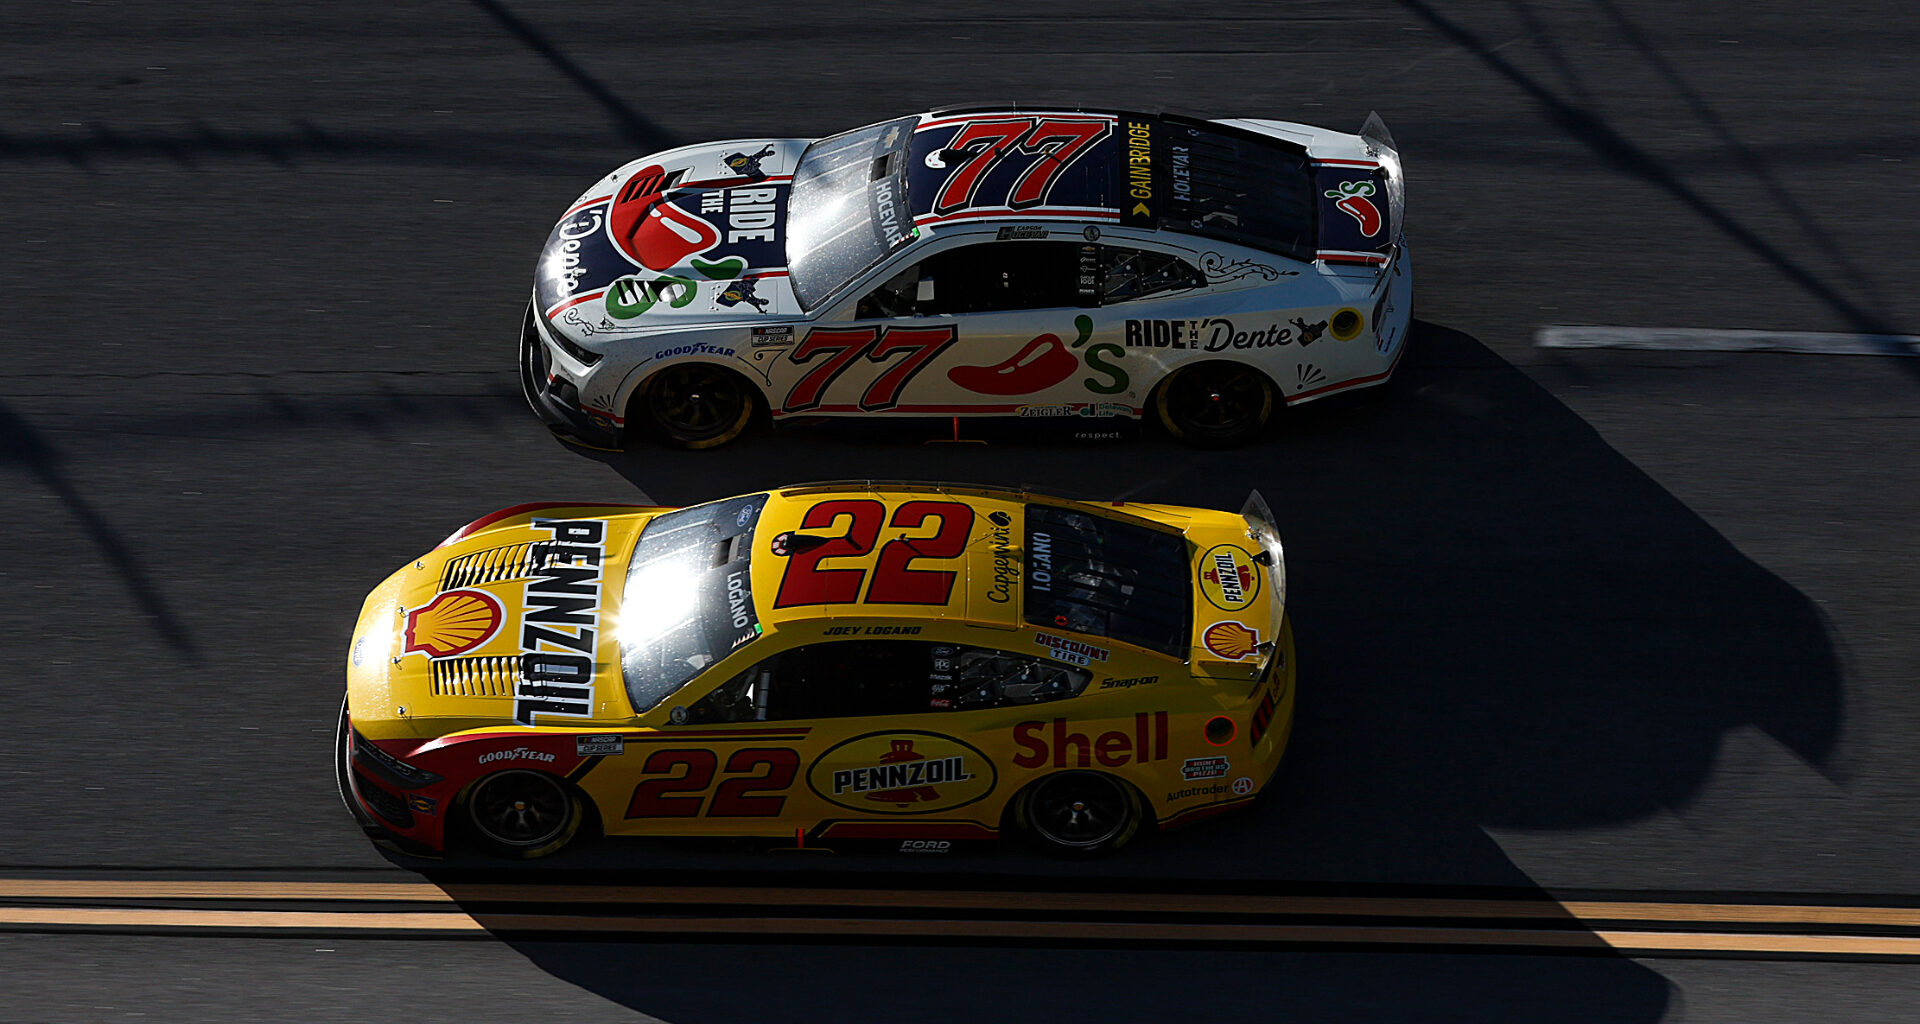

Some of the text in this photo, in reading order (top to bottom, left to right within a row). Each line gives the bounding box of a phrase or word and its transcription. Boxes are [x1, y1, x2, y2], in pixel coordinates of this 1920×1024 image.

[932, 115, 1112, 216] 77
[1128, 121, 1152, 199] GAINBRIDGE
[701, 190, 724, 214] THE
[728, 188, 778, 244] RIDE
[876, 181, 904, 249] HOCEVAR
[655, 342, 736, 360] GOODYEAR
[1125, 318, 1293, 352] RIDE THE 'Dente
[782, 325, 958, 412] 77
[1021, 406, 1072, 417] ZEIGLER
[773, 500, 975, 608] 22
[987, 527, 1019, 603] Capgemini
[1031, 532, 1052, 592] LOGANO
[1214, 552, 1245, 602] PENNZOIL
[513, 517, 608, 728] PENNZOIL
[727, 571, 749, 629] LOGANO
[823, 626, 922, 635] JOEY LOGANO
[1035, 632, 1109, 661] DISCOUNT
[1053, 649, 1085, 665] TIRE
[1100, 675, 1159, 689] Snap-on
[478, 747, 555, 764] GOODYEAR
[1012, 711, 1168, 769] Shell
[624, 747, 801, 819] 22
[834, 756, 971, 795] PENNZOIL
[1167, 784, 1229, 803] Autotrader
[901, 840, 951, 849] FORD
